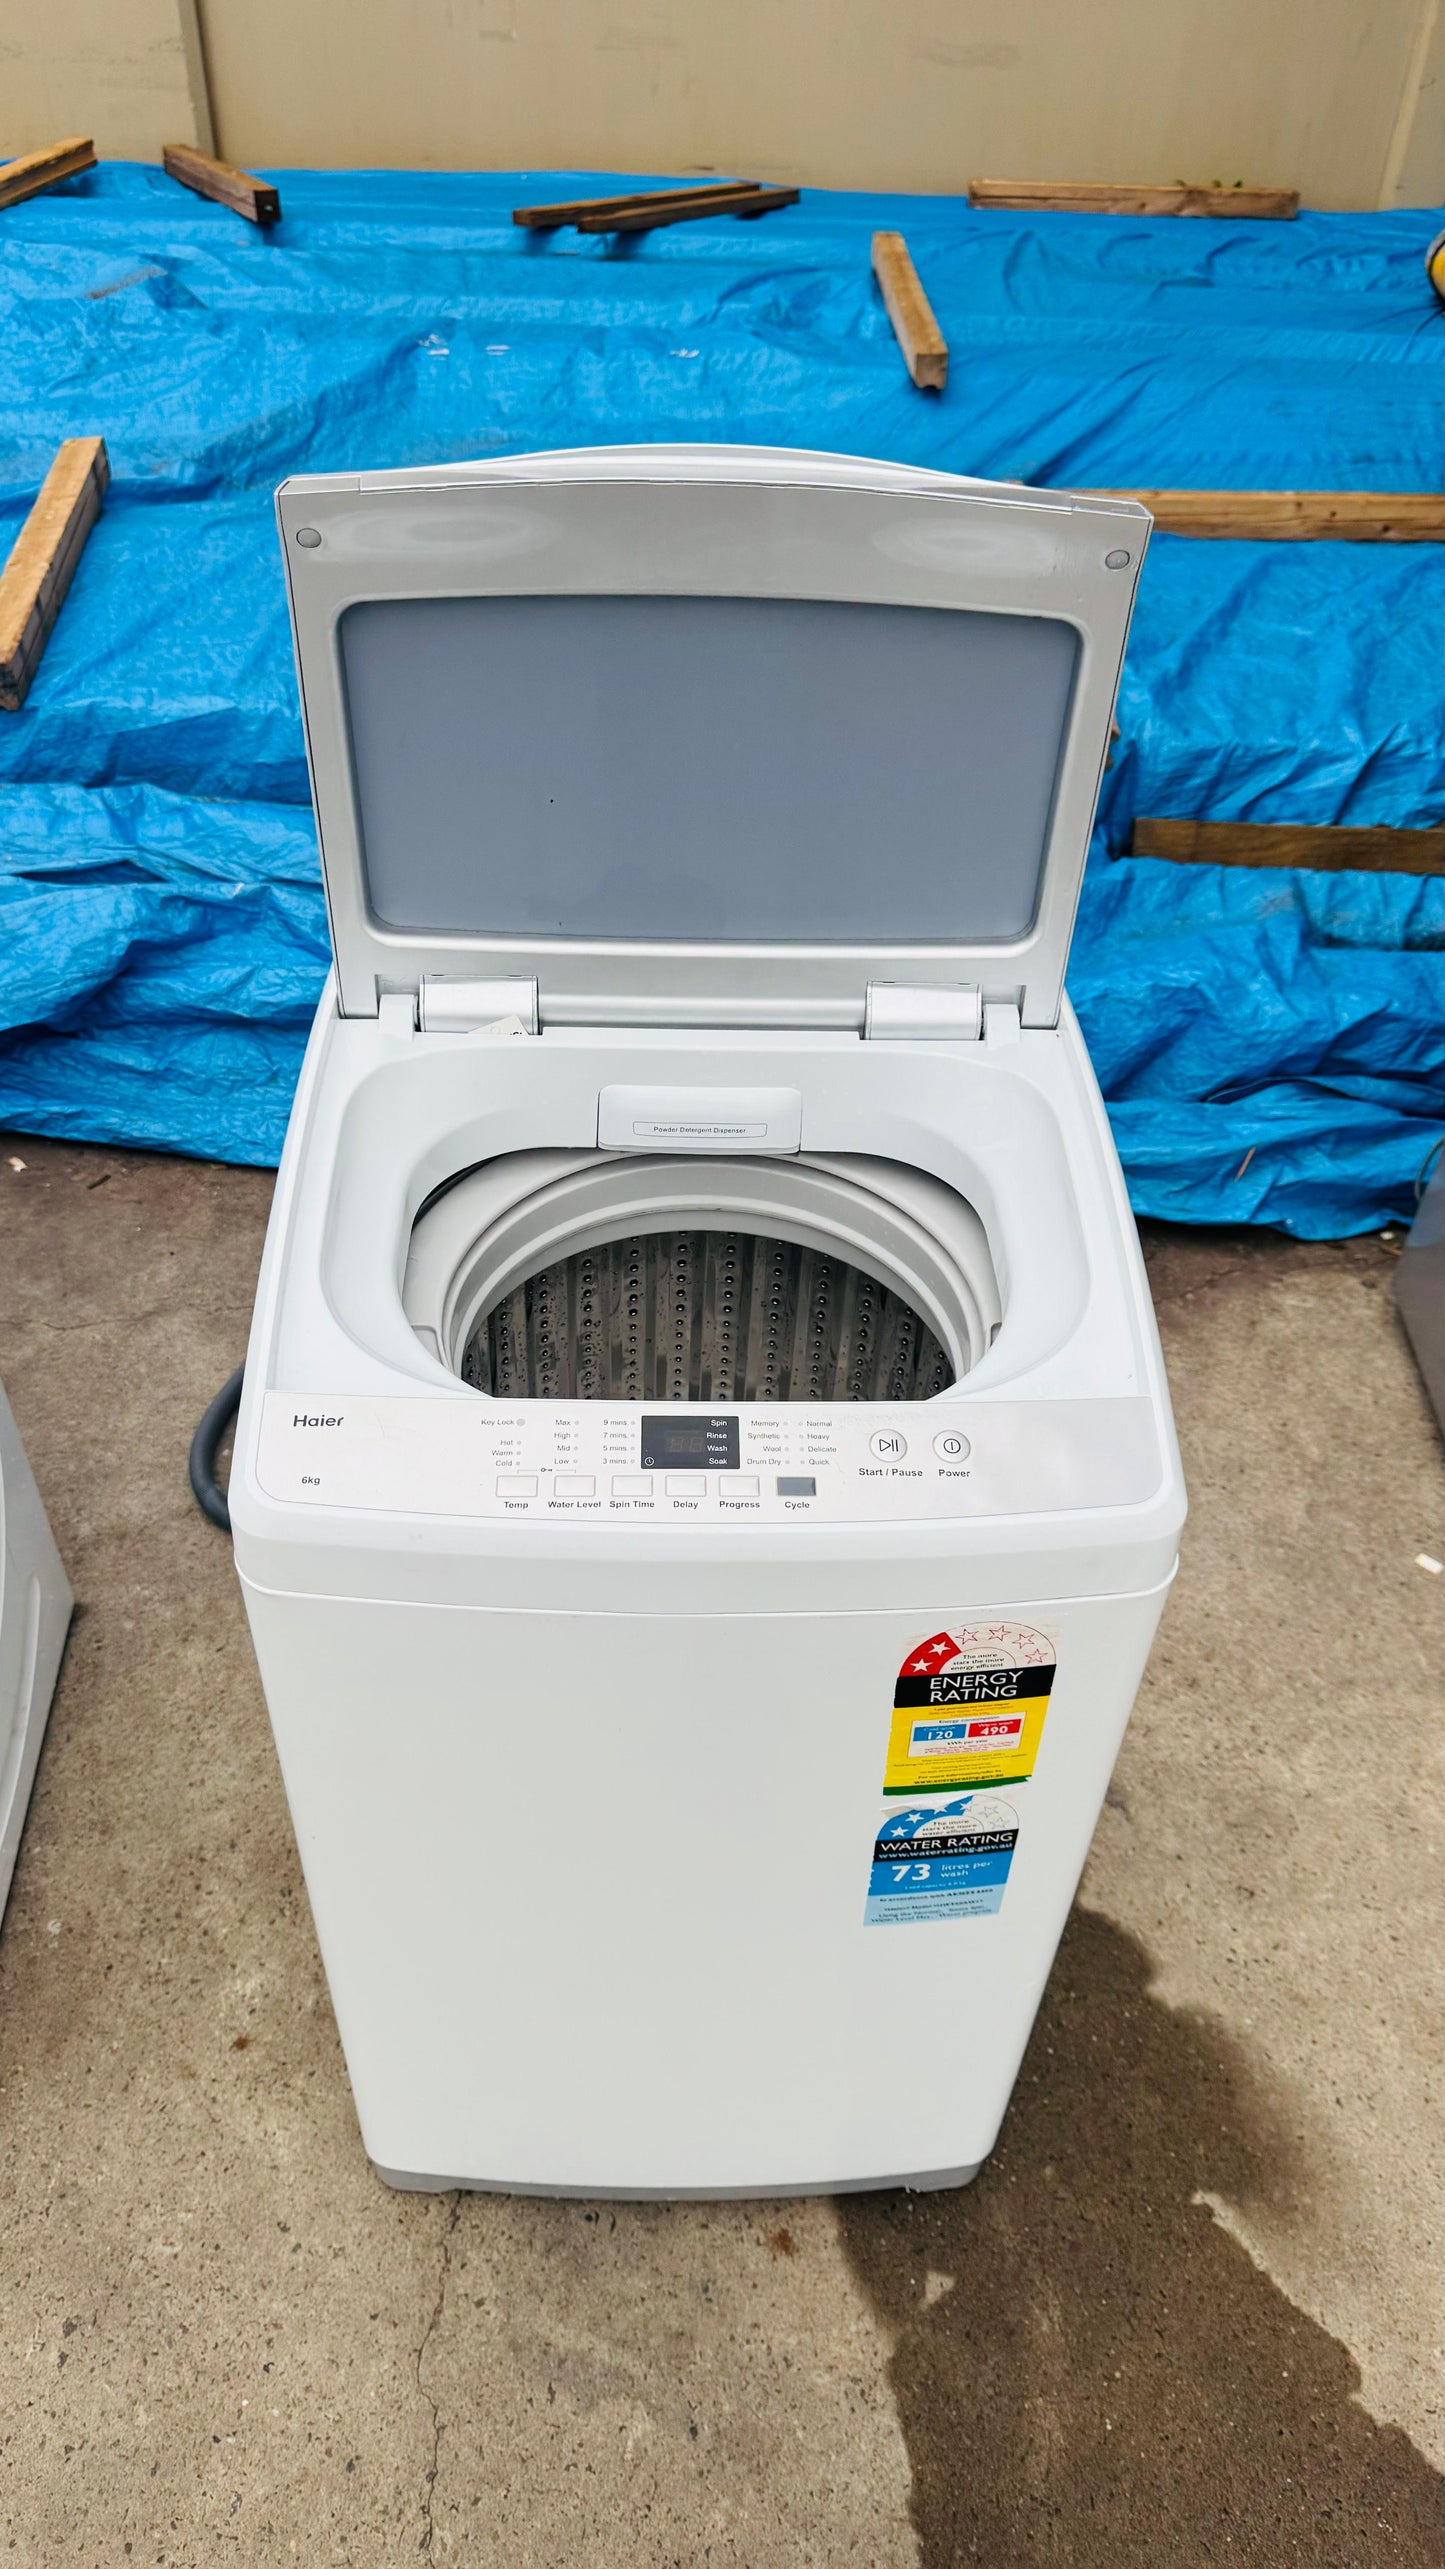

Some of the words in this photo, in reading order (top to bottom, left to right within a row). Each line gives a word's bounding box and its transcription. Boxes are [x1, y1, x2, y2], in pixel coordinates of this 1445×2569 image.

[293, 1414, 344, 1427] Haier
[751, 1420, 779, 1428] Memory
[807, 1433, 830, 1441] Heavy
[859, 1468, 883, 1476] Start
[886, 1468, 888, 1476] /
[892, 1468, 923, 1477] Pause
[938, 1469, 970, 1477] Power
[301, 1476, 320, 1485] 6kg
[610, 1501, 630, 1509] Spin
[673, 1501, 698, 1509] Delay
[719, 1501, 760, 1509] Progress
[785, 1501, 810, 1509] Cycle
[930, 1671, 1023, 1690] ENERGY
[930, 1685, 1018, 1703] RATING
[980, 1726, 1008, 1735] 490
[928, 1731, 953, 1740] 120
[881, 1840, 942, 1852] WATER
[947, 1832, 1014, 1848] RATING
[879, 1842, 1012, 1859] www.waterrating.gov.au
[942, 1863, 970, 1871] litres
[973, 1861, 993, 1870] per
[891, 1864, 931, 1882] 73
[941, 1870, 969, 1878] wash
